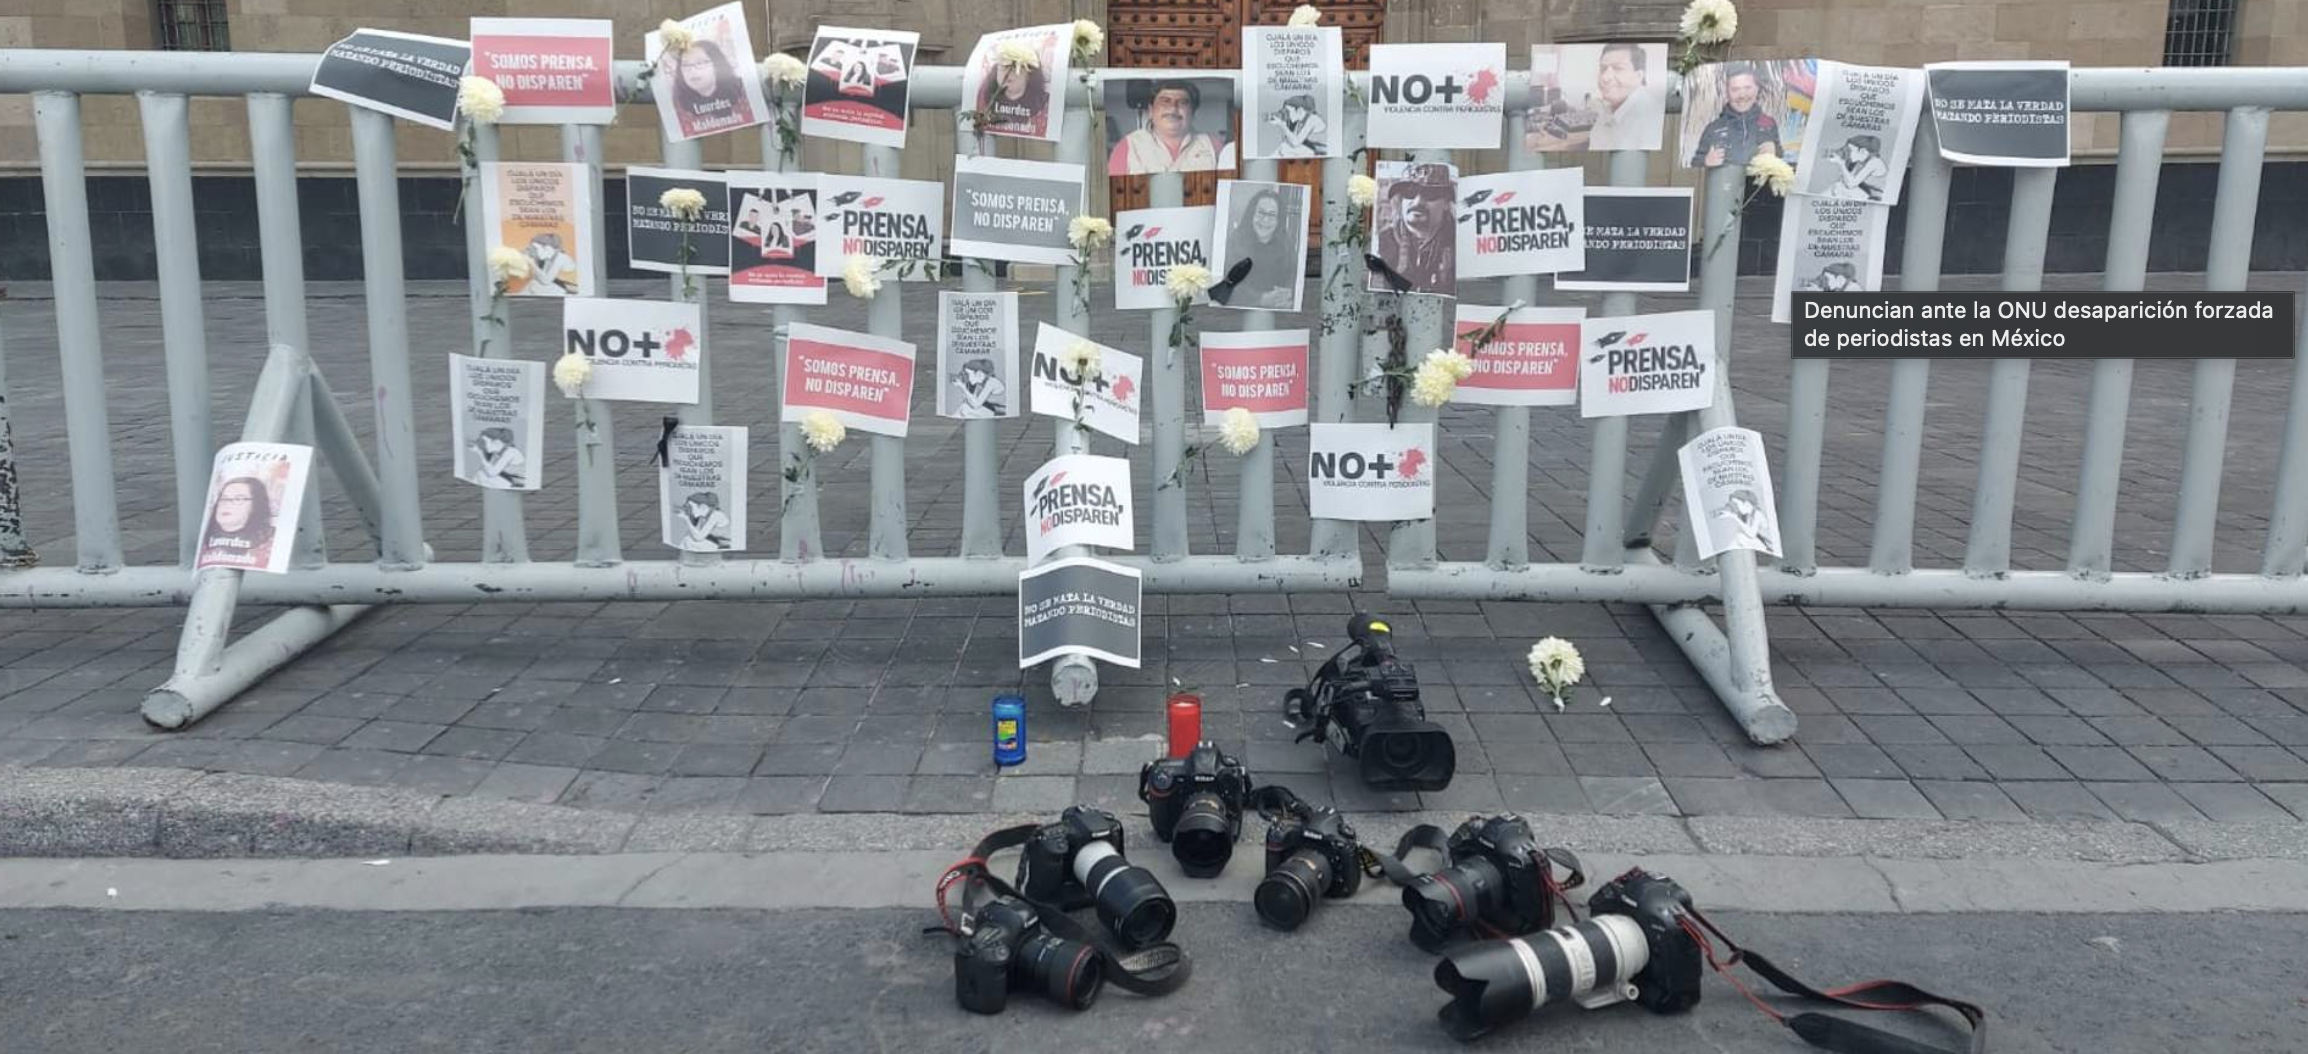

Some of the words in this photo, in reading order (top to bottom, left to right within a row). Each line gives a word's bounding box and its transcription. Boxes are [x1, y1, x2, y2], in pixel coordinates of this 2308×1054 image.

[417, 56, 462, 76] VERDAD
[484, 51, 535, 72] "SOMOS
[495, 75, 513, 90] NO
[516, 76, 590, 93] DISPAREN"
[1372, 74, 1463, 104] NO+
[693, 99, 732, 115] Lourdes
[995, 101, 1031, 117] Lourdes
[1935, 98, 1948, 109] NO
[1949, 100, 1965, 110] SE
[1967, 100, 1997, 110] MATA
[1999, 101, 2014, 111] LA
[2016, 102, 2065, 111] VERDAD
[692, 112, 744, 131] Maldonado
[1984, 113, 2066, 124] PERIODISTAS
[965, 189, 1014, 210] "SOMOS
[842, 210, 933, 243] PRENSA,
[972, 211, 990, 228] NO
[993, 213, 1059, 233] DISPAREN"
[1475, 203, 1576, 236] PRENSA,
[1596, 226, 1624, 237] MATA
[1626, 226, 1640, 237] LA
[1642, 226, 1687, 237] VERDAD
[1132, 239, 1207, 268] PRENSA,
[1612, 240, 1686, 250] PERIODISTAS
[567, 329, 661, 358] NO+
[1517, 342, 1568, 357] PRENSA,
[798, 355, 847, 378] "SOMOS
[1493, 358, 1559, 374] DISPAREN"
[1607, 344, 1706, 375] PRENSA,
[1211, 362, 1257, 380] "SOMOS
[1259, 363, 1299, 380] PRENSA,
[805, 377, 822, 393] NO
[825, 382, 889, 403] DISPAREN"
[1221, 383, 1236, 398] NO
[1311, 452, 1394, 480] NO+
[1039, 484, 1124, 520] PRENSA,
[209, 536, 251, 550] Lourdes
[1024, 603, 1037, 616] NO
[1039, 598, 1052, 611] SE
[1053, 592, 1081, 606] MATA
[1082, 593, 1097, 604] LA
[1097, 596, 1136, 615] VERDAD
[1024, 606, 1066, 628] MATANDO
[1068, 605, 1136, 628] PERIODISTAS
